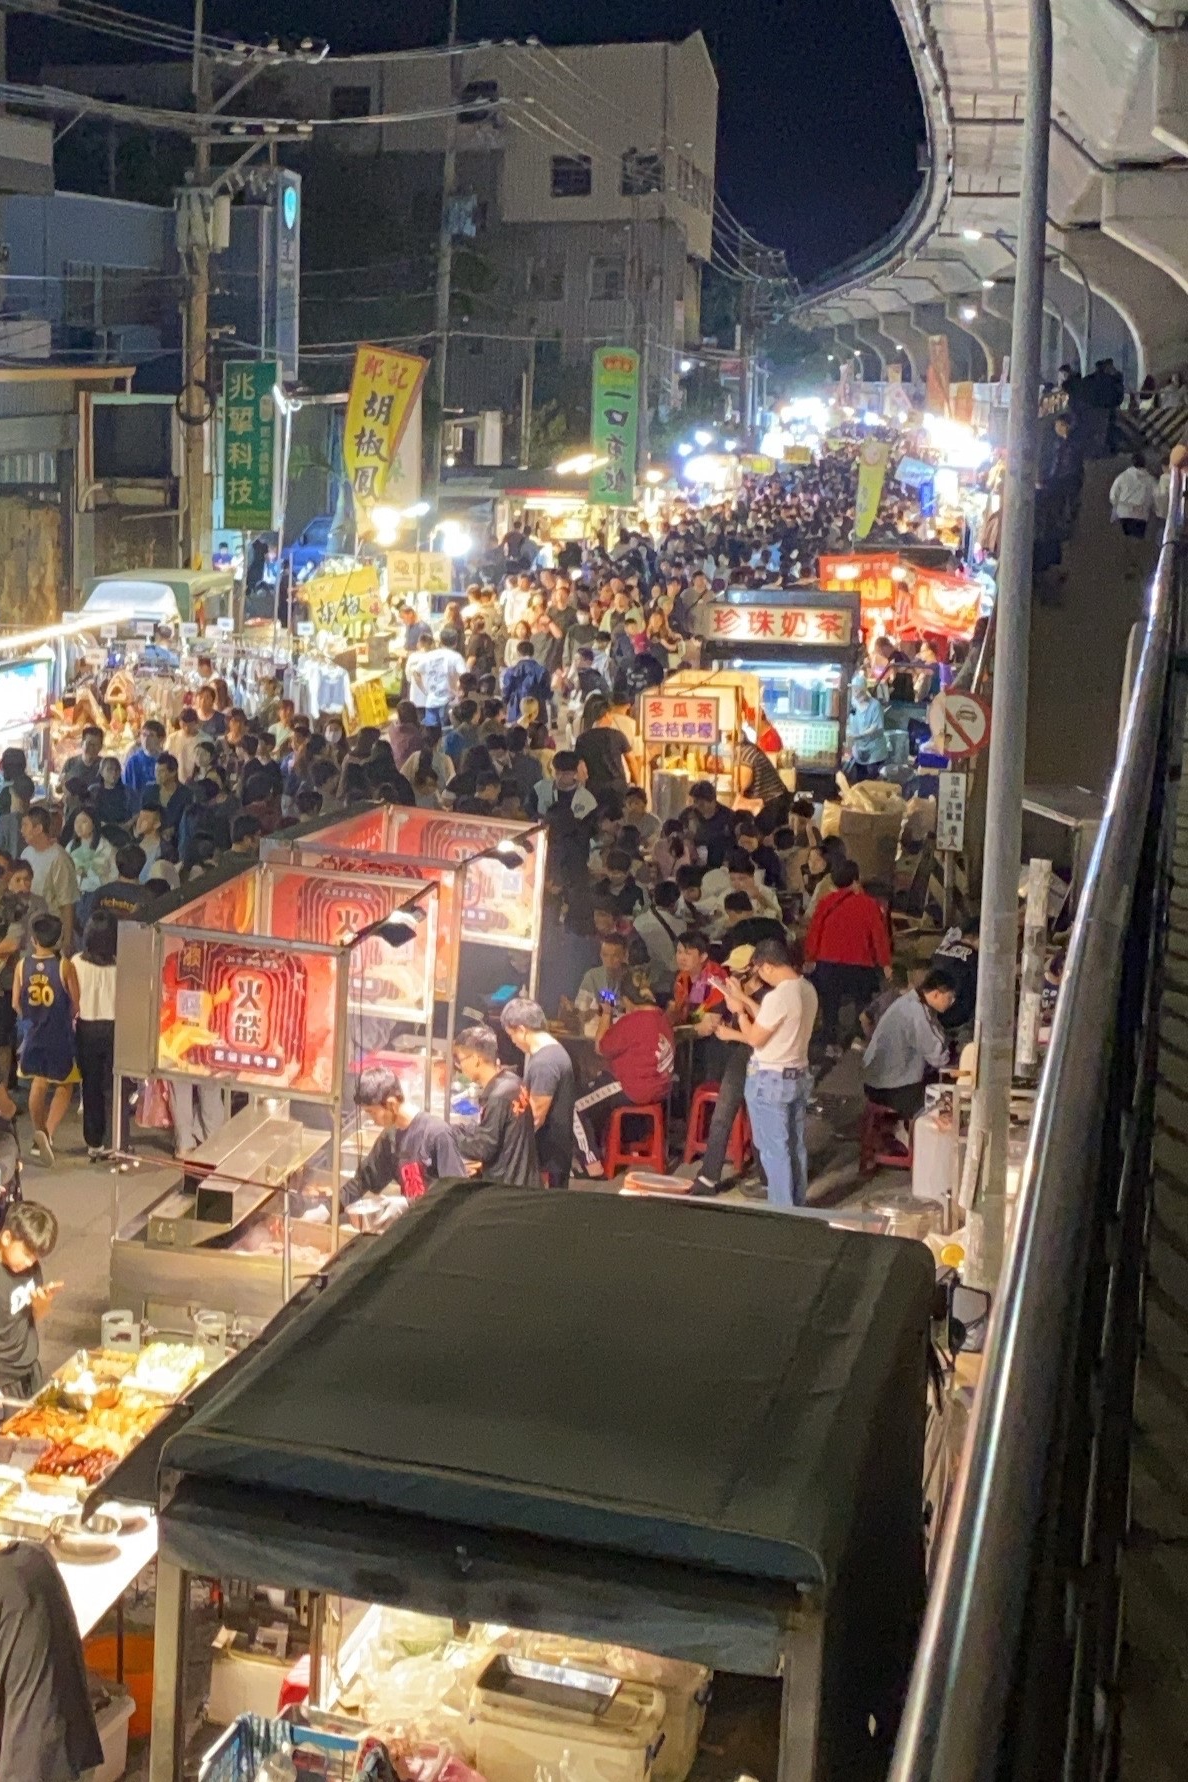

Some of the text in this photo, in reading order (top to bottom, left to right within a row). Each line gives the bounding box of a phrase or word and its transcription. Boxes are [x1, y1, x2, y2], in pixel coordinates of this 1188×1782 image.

[714, 609, 843, 640] 珍珠奶茶
[649, 702, 712, 719] 冬瓜茶
[649, 722, 712, 738] 金桔檸檬
[28, 985, 54, 1008] 30
